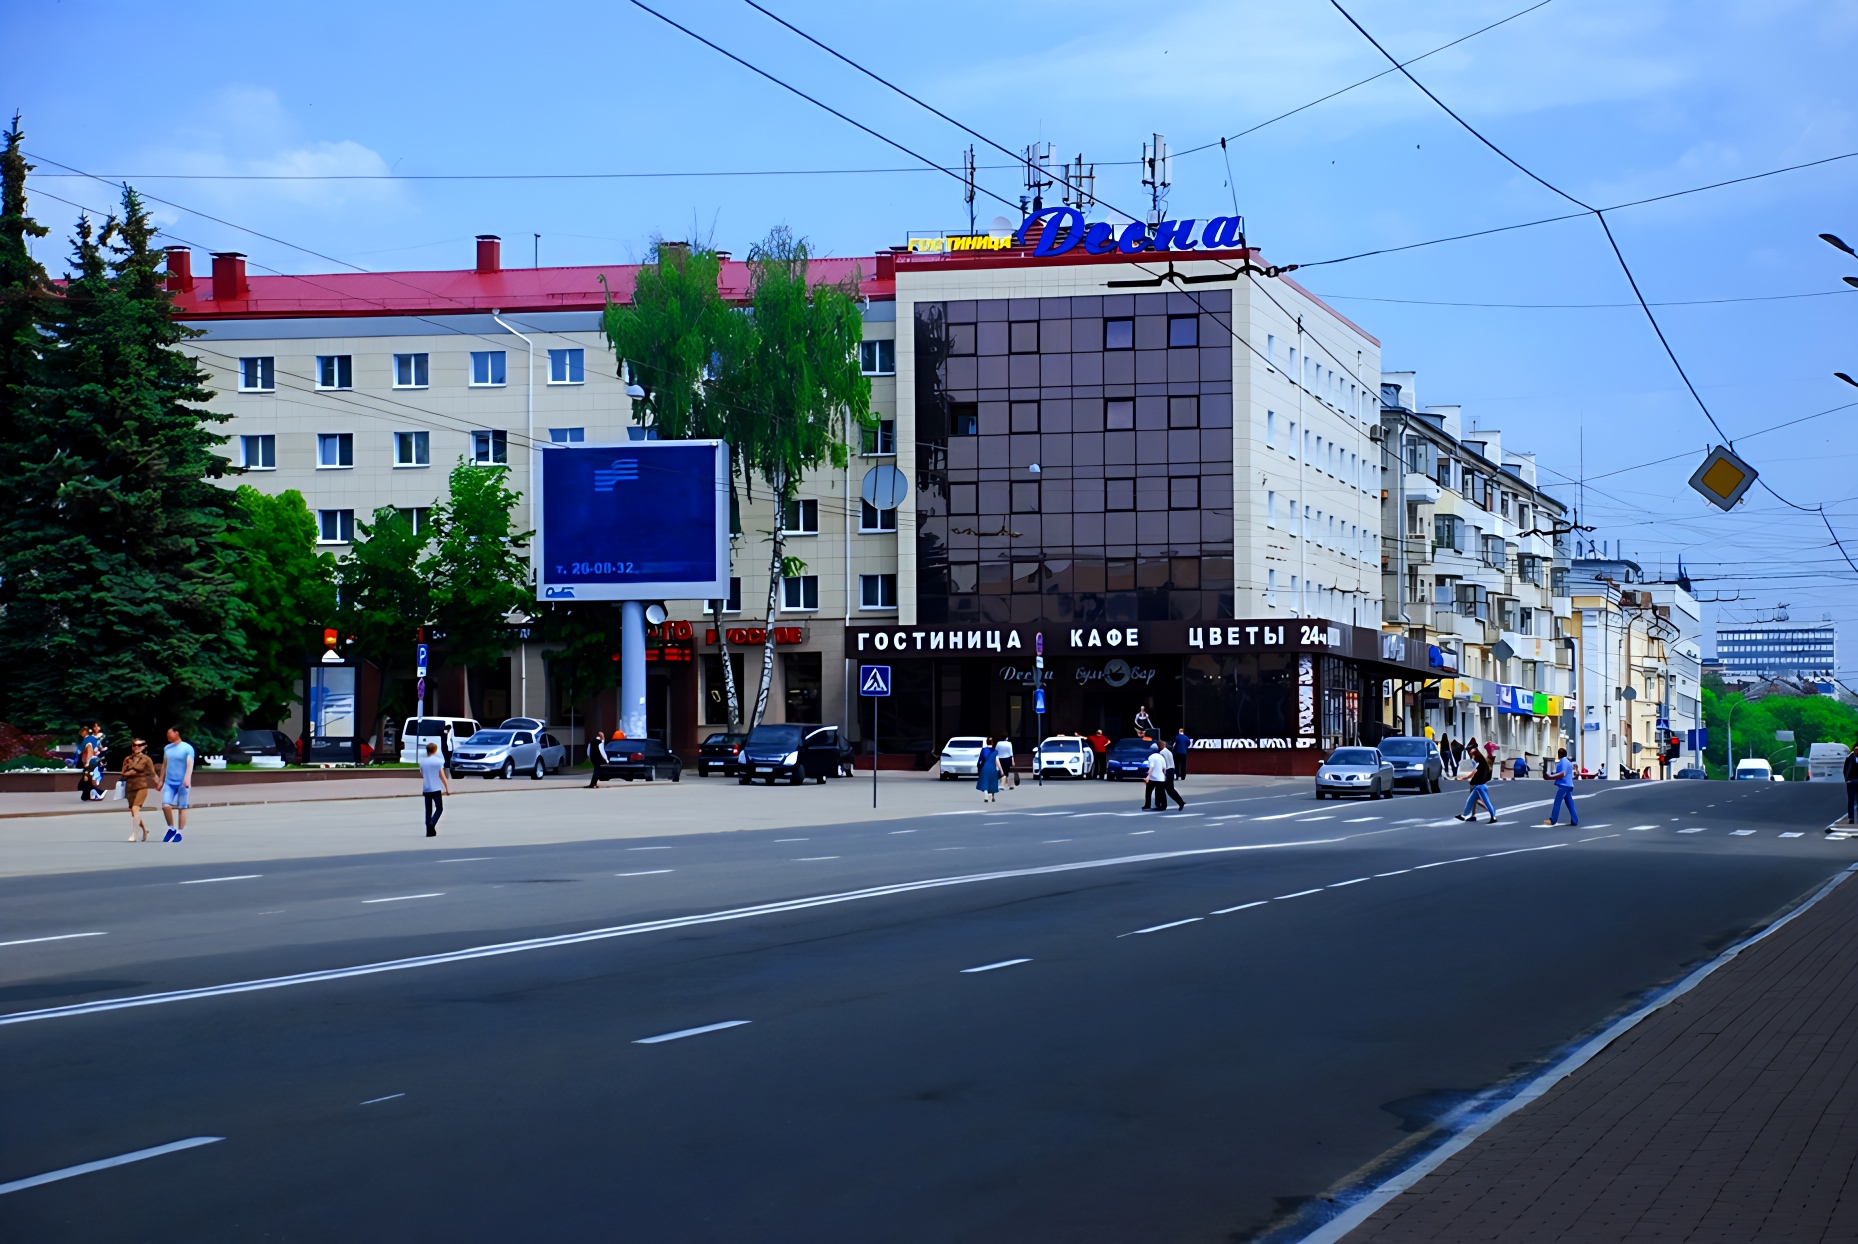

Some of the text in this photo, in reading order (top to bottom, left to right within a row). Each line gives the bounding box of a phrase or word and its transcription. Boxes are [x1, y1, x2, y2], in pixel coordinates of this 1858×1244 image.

[1016, 206, 1242, 257] Десна
[858, 630, 1021, 652] ГОСТИНИЦА
[1070, 628, 1139, 647] КАФЕ
[1189, 626, 1284, 649] ЦВЕТЫ
